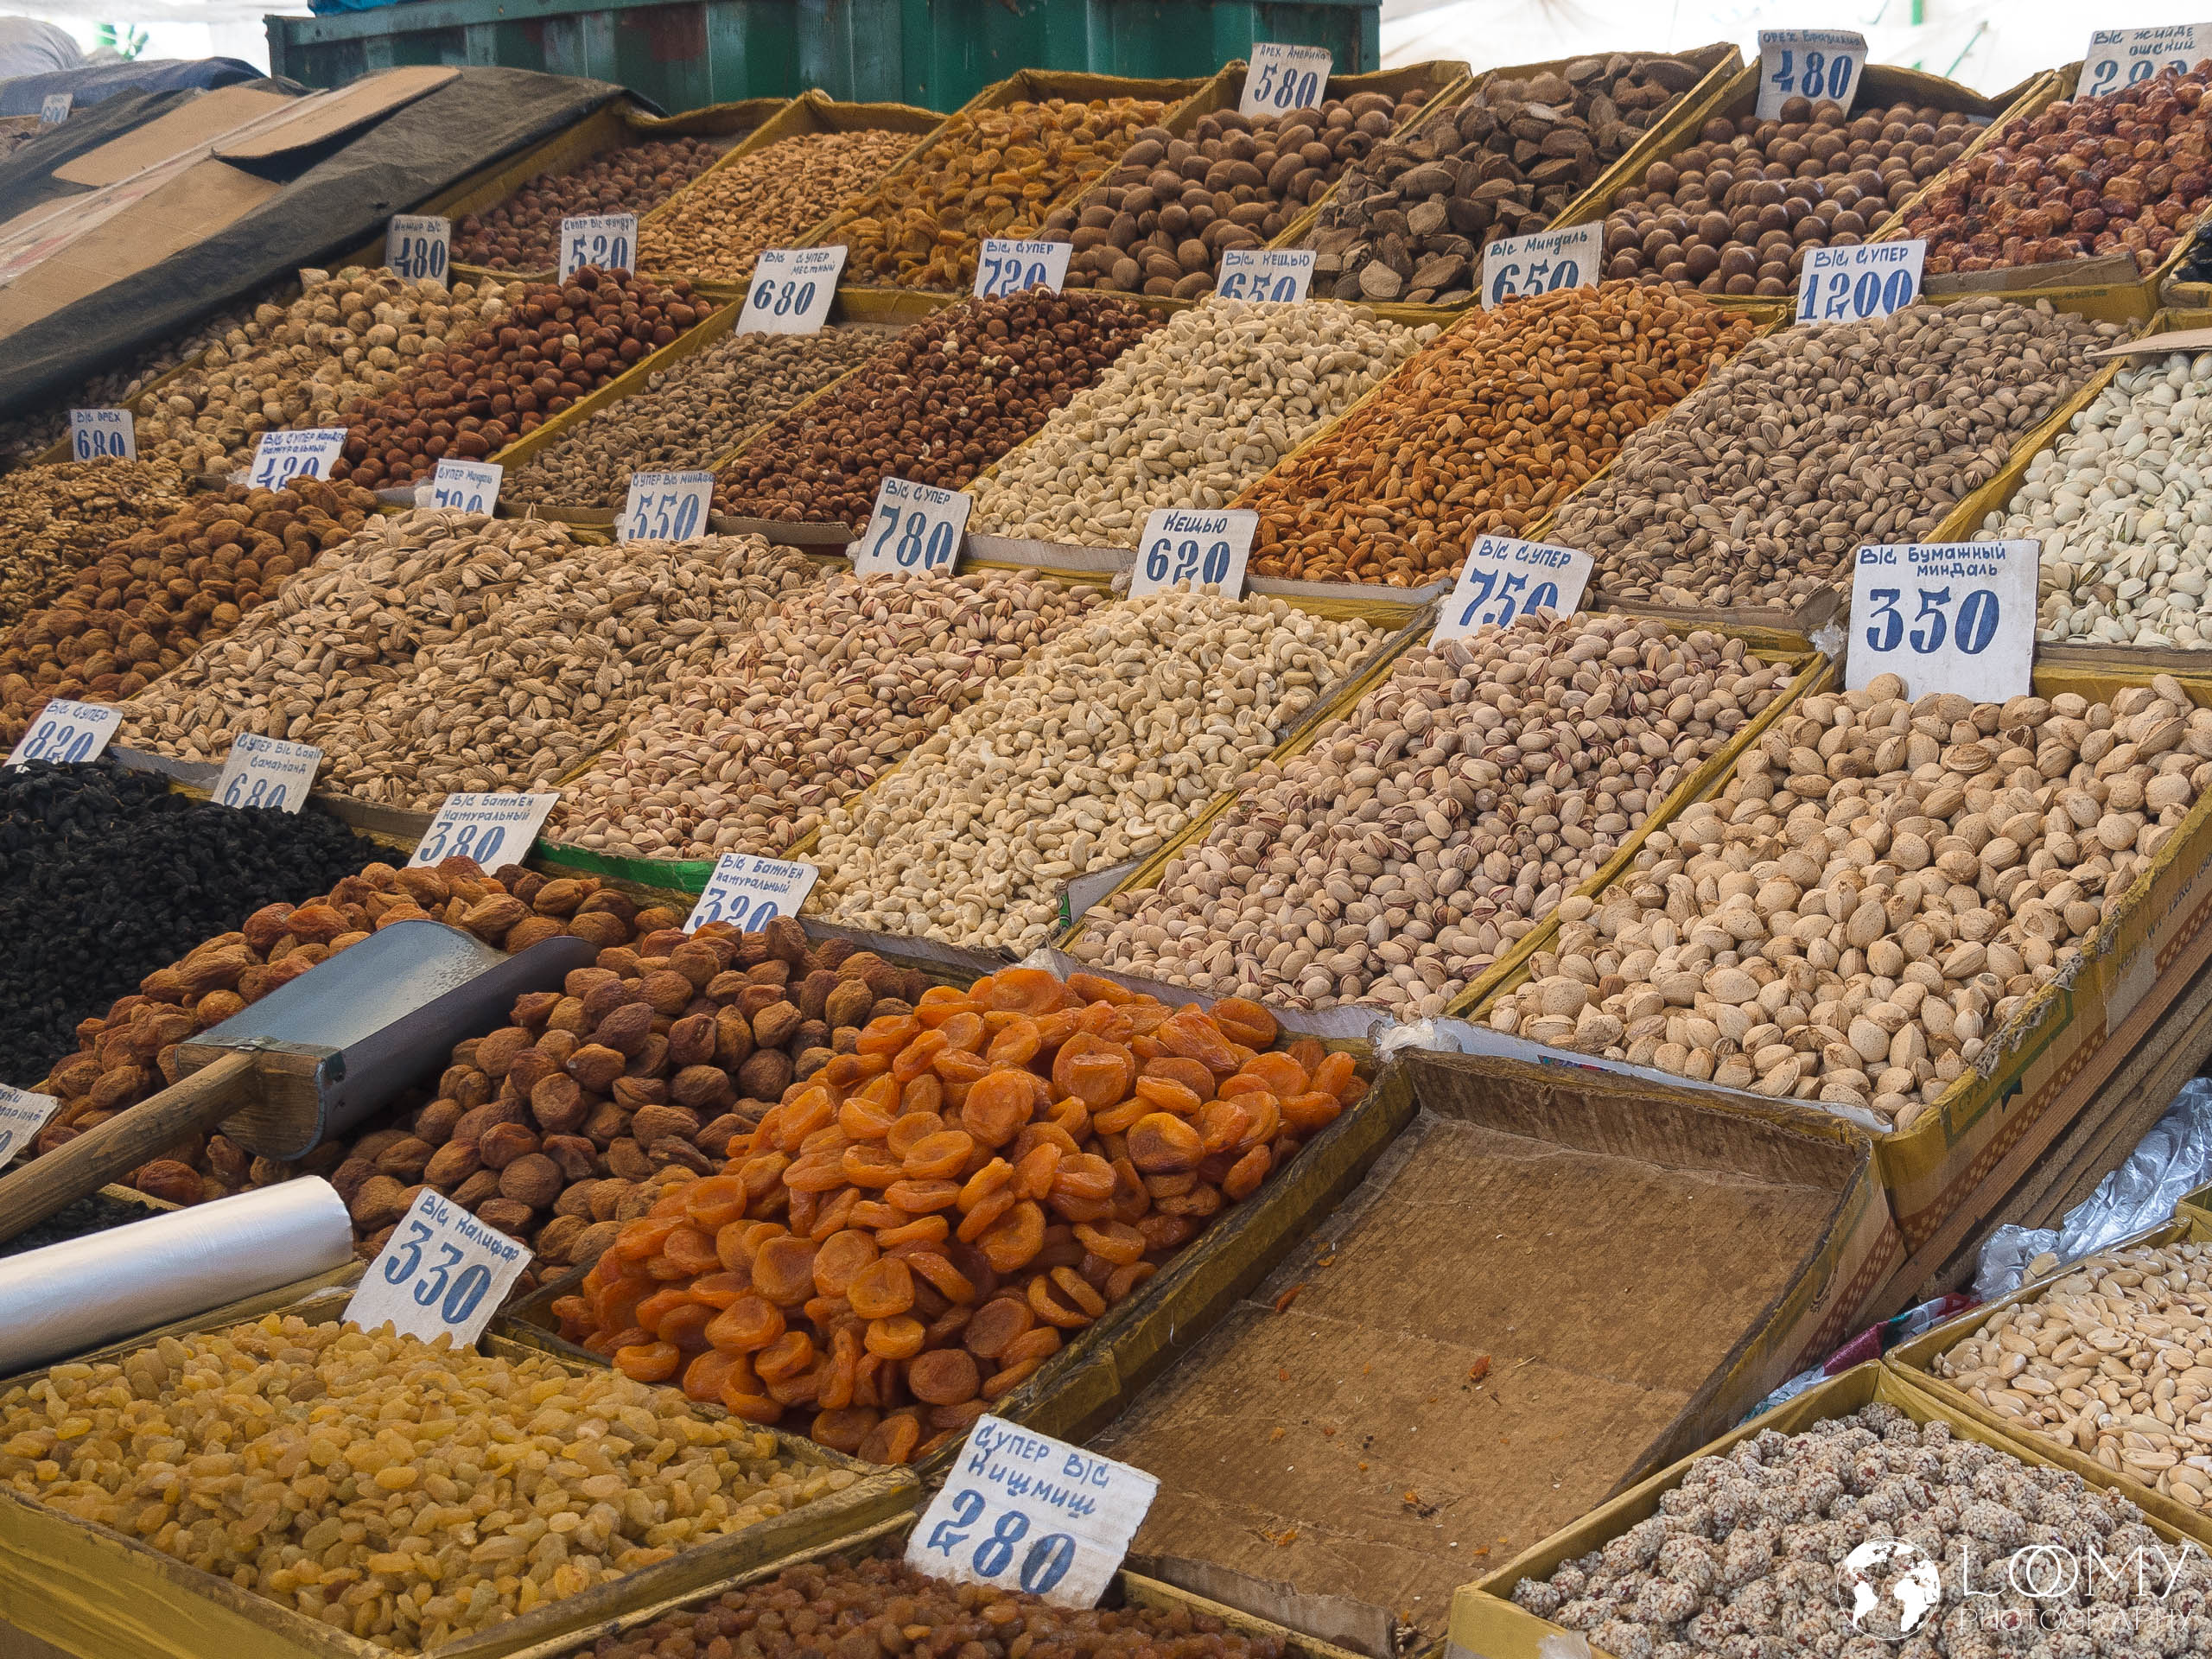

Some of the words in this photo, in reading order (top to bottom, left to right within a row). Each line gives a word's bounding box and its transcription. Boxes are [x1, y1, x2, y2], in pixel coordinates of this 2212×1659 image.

[1254, 63, 1319, 110] 580
[1771, 49, 1853, 99] 480
[394, 238, 446, 278] 480
[568, 234, 628, 275] 520
[1855, 246, 1908, 265] СУПЕР
[753, 279, 817, 315] 680
[982, 257, 1046, 298] 720
[1220, 272, 1297, 302] 650
[1491, 258, 1580, 305] 650
[1798, 269, 1913, 320] 1200
[77, 429, 126, 460] 680
[256, 456, 320, 491] 420
[628, 491, 699, 541] 550
[913, 485, 950, 505] СУПЕР
[872, 504, 954, 570] 780
[1146, 537, 1230, 586] 620
[1515, 549, 1572, 569] СУПЕР
[1459, 568, 1559, 629] 750
[1866, 586, 2000, 655] 350
[23, 721, 94, 763] 820
[224, 772, 288, 808] 680
[420, 822, 505, 865] 380
[694, 887, 779, 933] 320
[385, 1218, 493, 1325] 330
[975, 1424, 1051, 1461] СУПЕР
[927, 1488, 1077, 1595] 280
